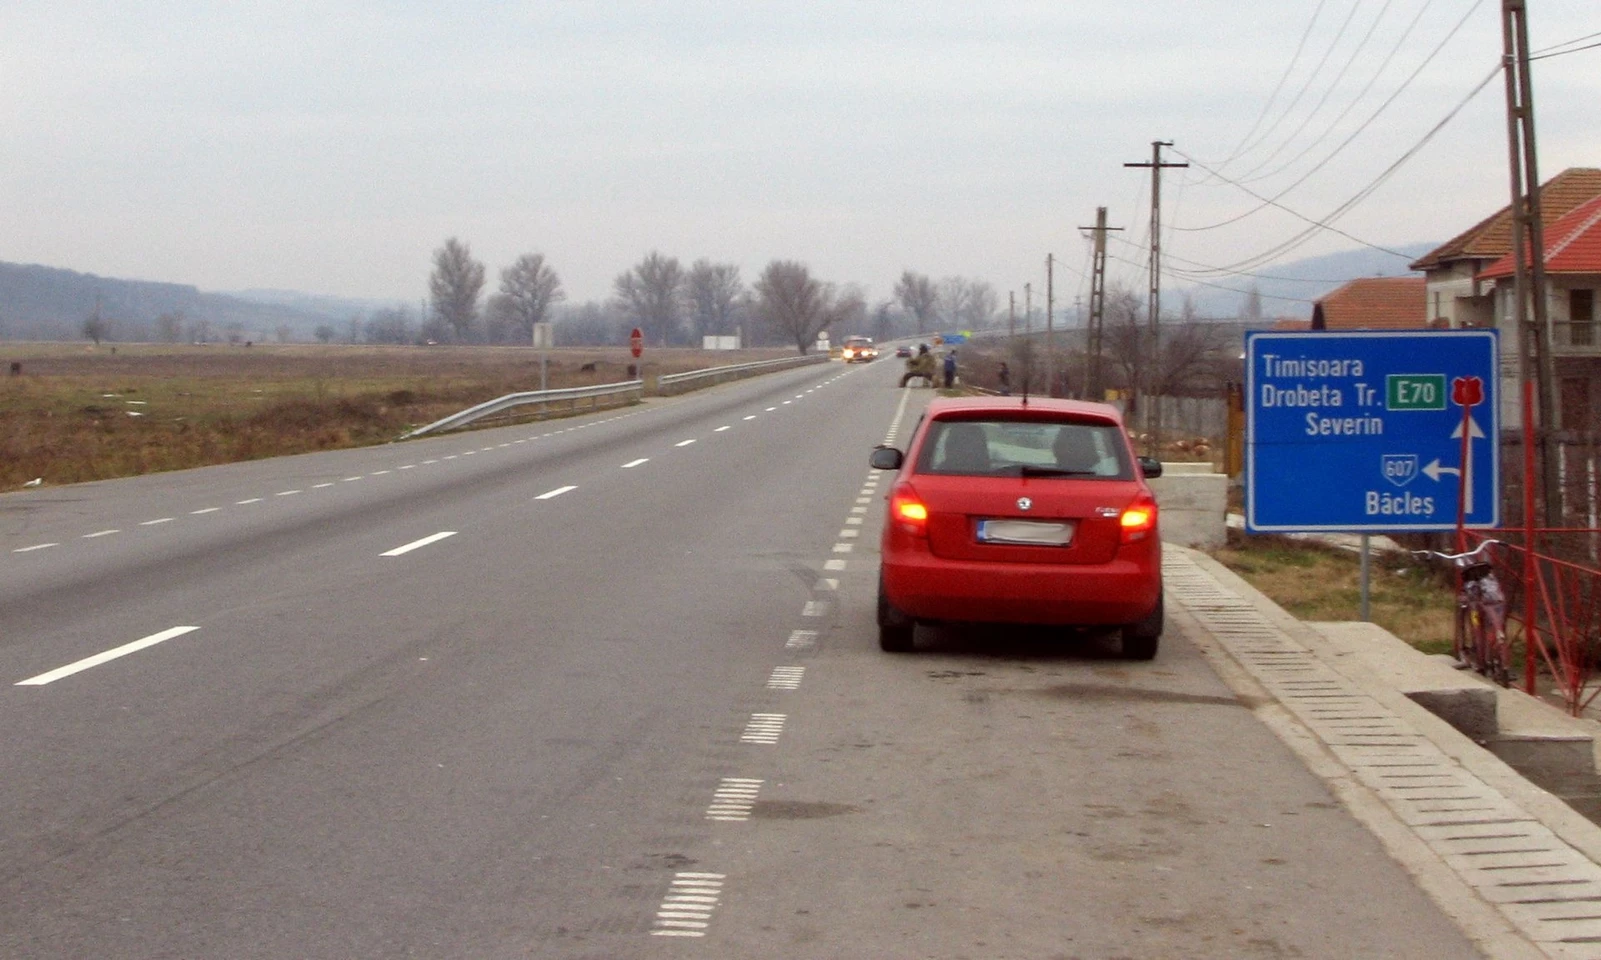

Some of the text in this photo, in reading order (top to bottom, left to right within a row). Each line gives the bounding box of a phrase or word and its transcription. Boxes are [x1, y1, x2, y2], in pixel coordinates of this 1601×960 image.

[1263, 354, 1363, 381] Timișoara
[1262, 383, 1383, 407] Drobeta Tr.
[1397, 380, 1435, 403] E70
[1306, 412, 1383, 435] Severin
[1385, 460, 1414, 478] 607
